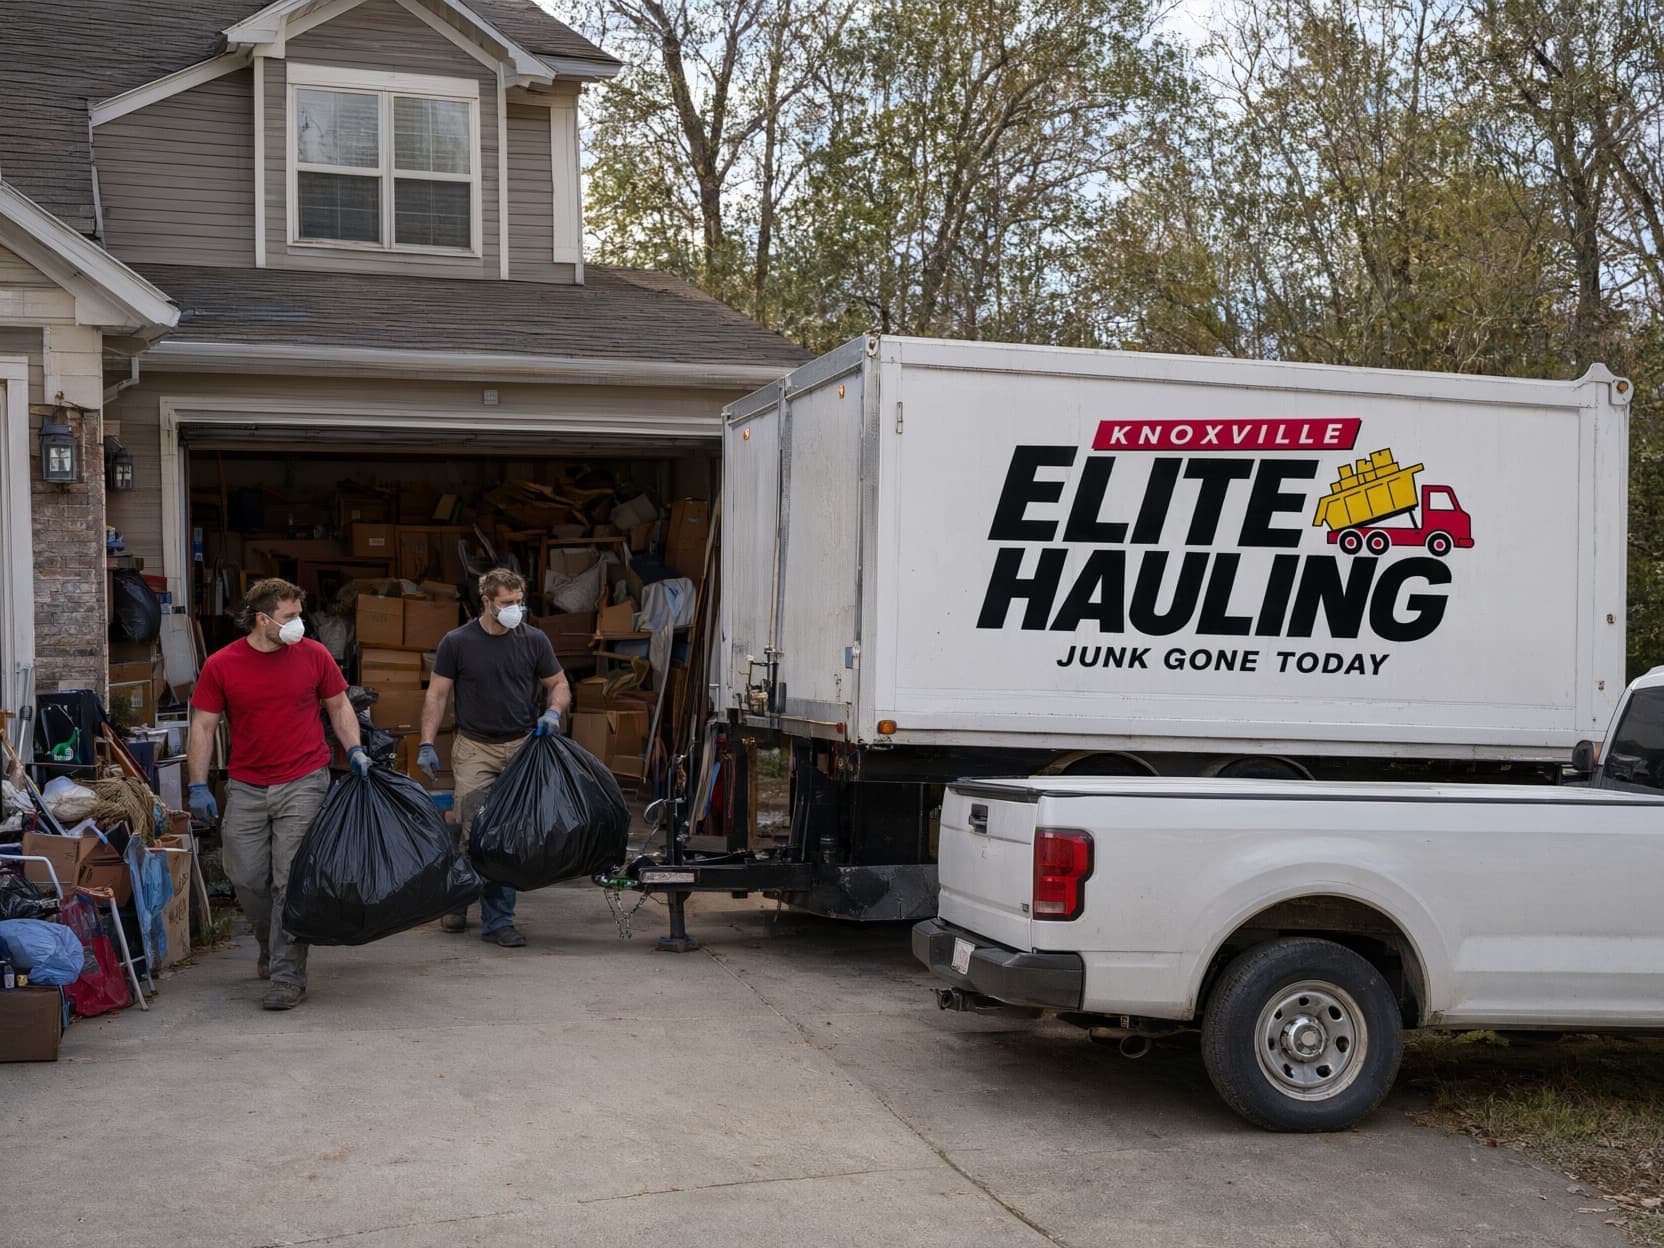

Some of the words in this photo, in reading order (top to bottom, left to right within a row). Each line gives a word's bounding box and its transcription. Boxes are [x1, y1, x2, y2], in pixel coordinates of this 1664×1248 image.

[1109, 424, 1344, 445] KNOXVILLE
[987, 444, 1321, 548] ELITE
[975, 547, 1454, 643] HAULING
[1056, 645, 1152, 669] JUNK
[1163, 647, 1261, 673] GONE
[1276, 651, 1391, 676] TODAY
